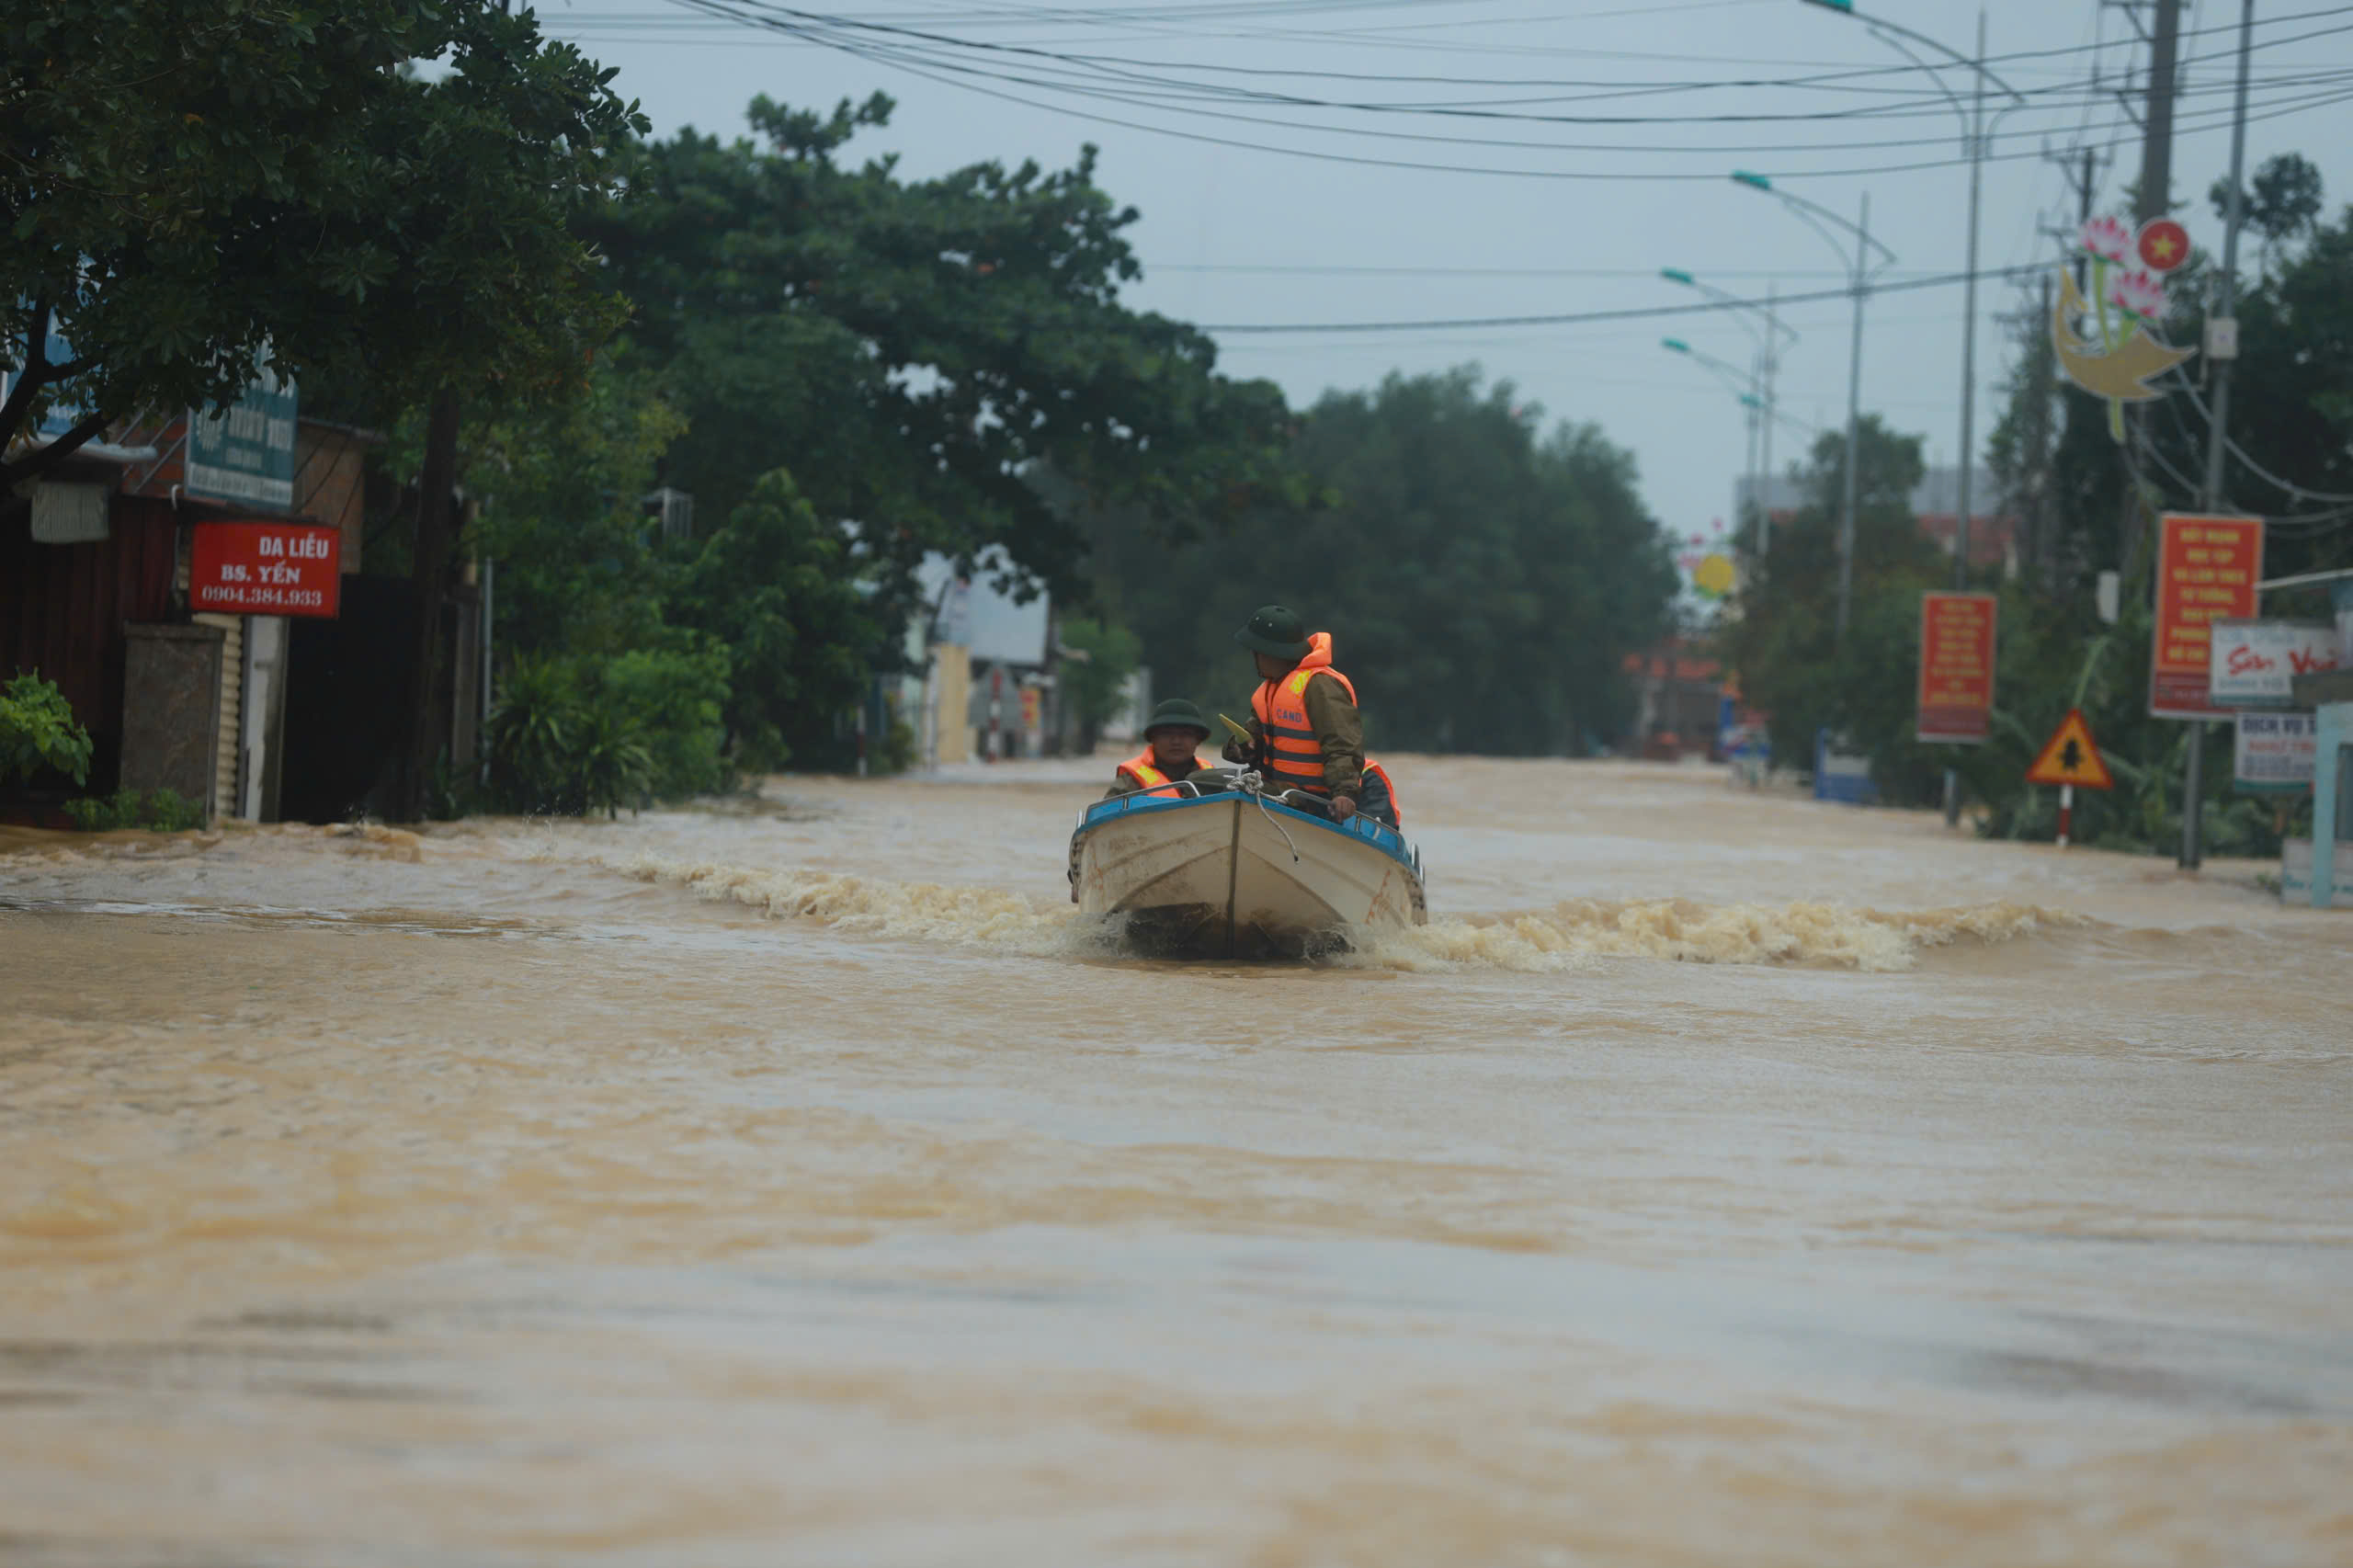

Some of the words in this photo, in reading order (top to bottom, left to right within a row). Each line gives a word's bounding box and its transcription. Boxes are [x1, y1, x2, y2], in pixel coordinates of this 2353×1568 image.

[259, 536, 284, 557] DA
[221, 563, 252, 582] BS.
[258, 559, 301, 585] YẾN
[201, 585, 323, 607] 0904.384.933
